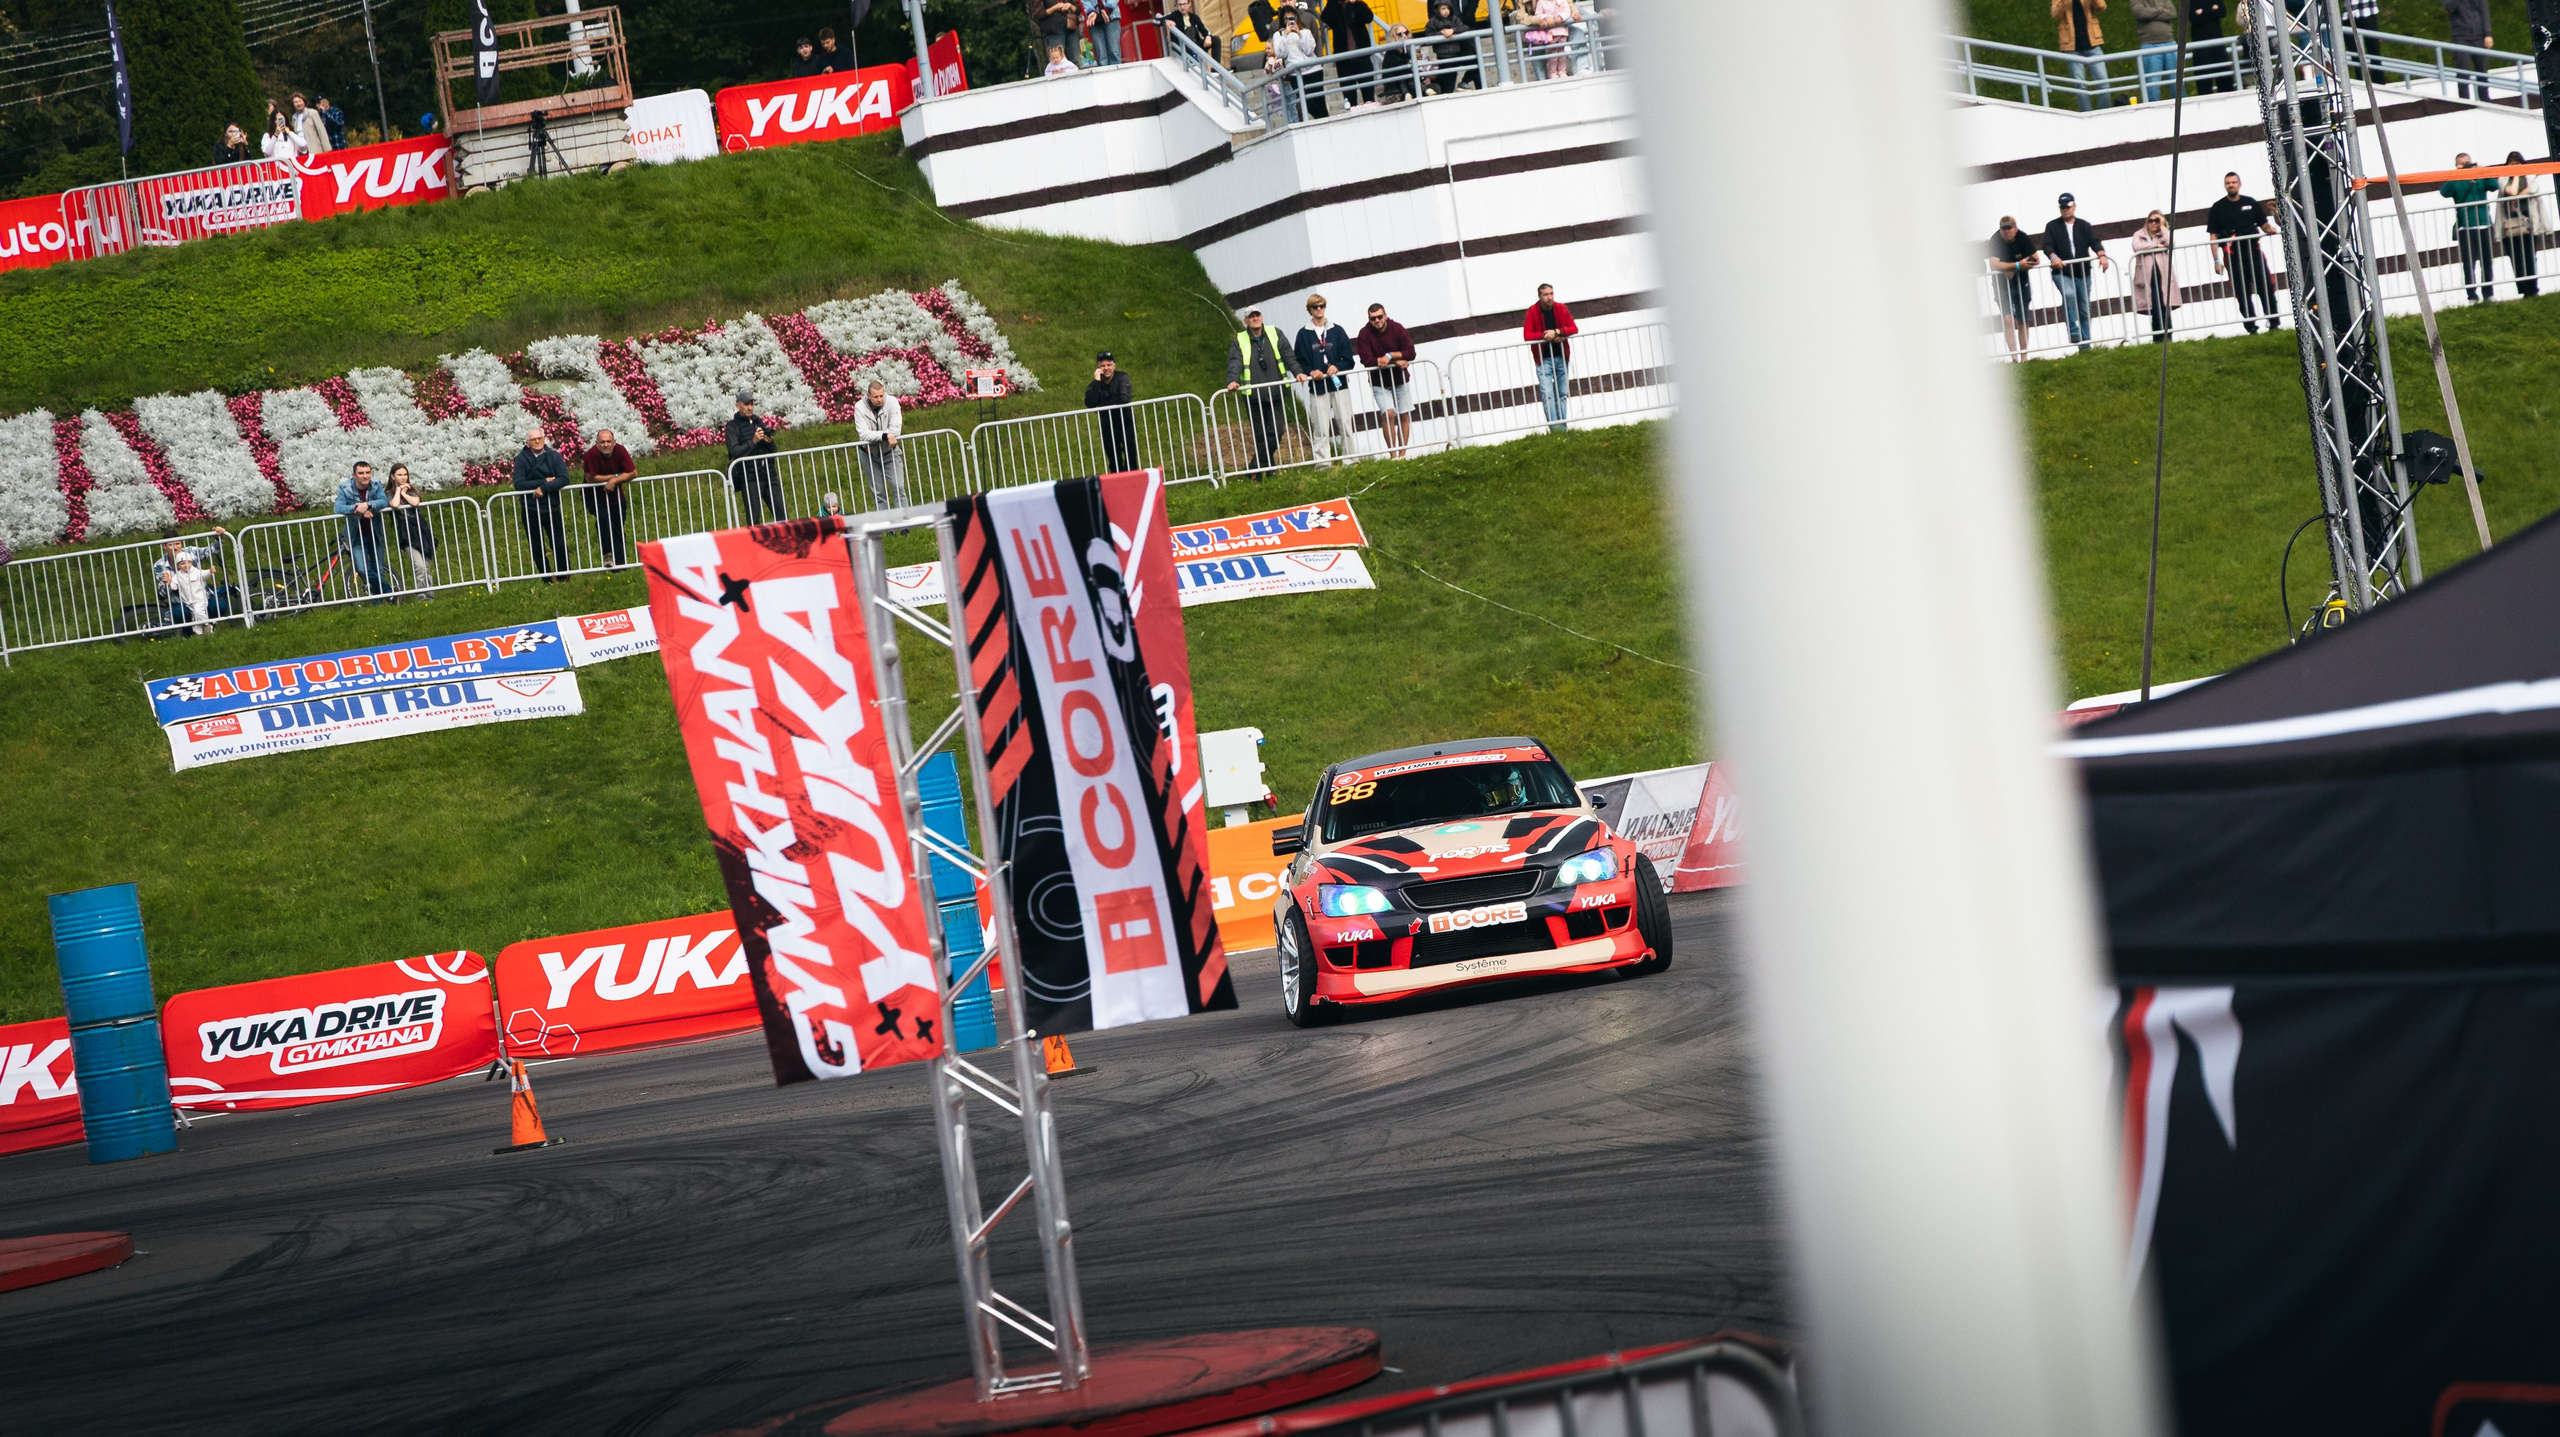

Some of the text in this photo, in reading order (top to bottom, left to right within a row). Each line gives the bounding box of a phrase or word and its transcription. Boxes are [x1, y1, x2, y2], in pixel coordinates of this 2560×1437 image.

[746, 80, 892, 137] YUKA
[330, 147, 451, 204] YUK
[583, 613, 628, 628] Pyrmo
[201, 634, 518, 700] AUTORUL.BY
[250, 687, 301, 703] ПРО
[258, 681, 494, 732] DINITROL
[265, 725, 342, 740] НАДЕЖНАЯ
[346, 715, 400, 729] ЗАЩИТА
[426, 704, 496, 717] КОРРОЗИИ
[493, 704, 566, 717] 694-8000
[190, 718, 236, 732] Pyrmo
[193, 733, 333, 761] WWW.DINITROL.BY
[750, 572, 938, 1004] YUKA
[1330, 781, 1378, 805] 88
[661, 532, 861, 1080] GYMKHANA
[1623, 814, 1659, 842] YUKA
[1428, 843, 1511, 863] FORTIS
[1580, 894, 1616, 908] YUKA
[1337, 929, 1373, 943] YUKA
[207, 995, 437, 1056] YUKA DRIVE
[287, 1025, 423, 1063] GYMKHANA
